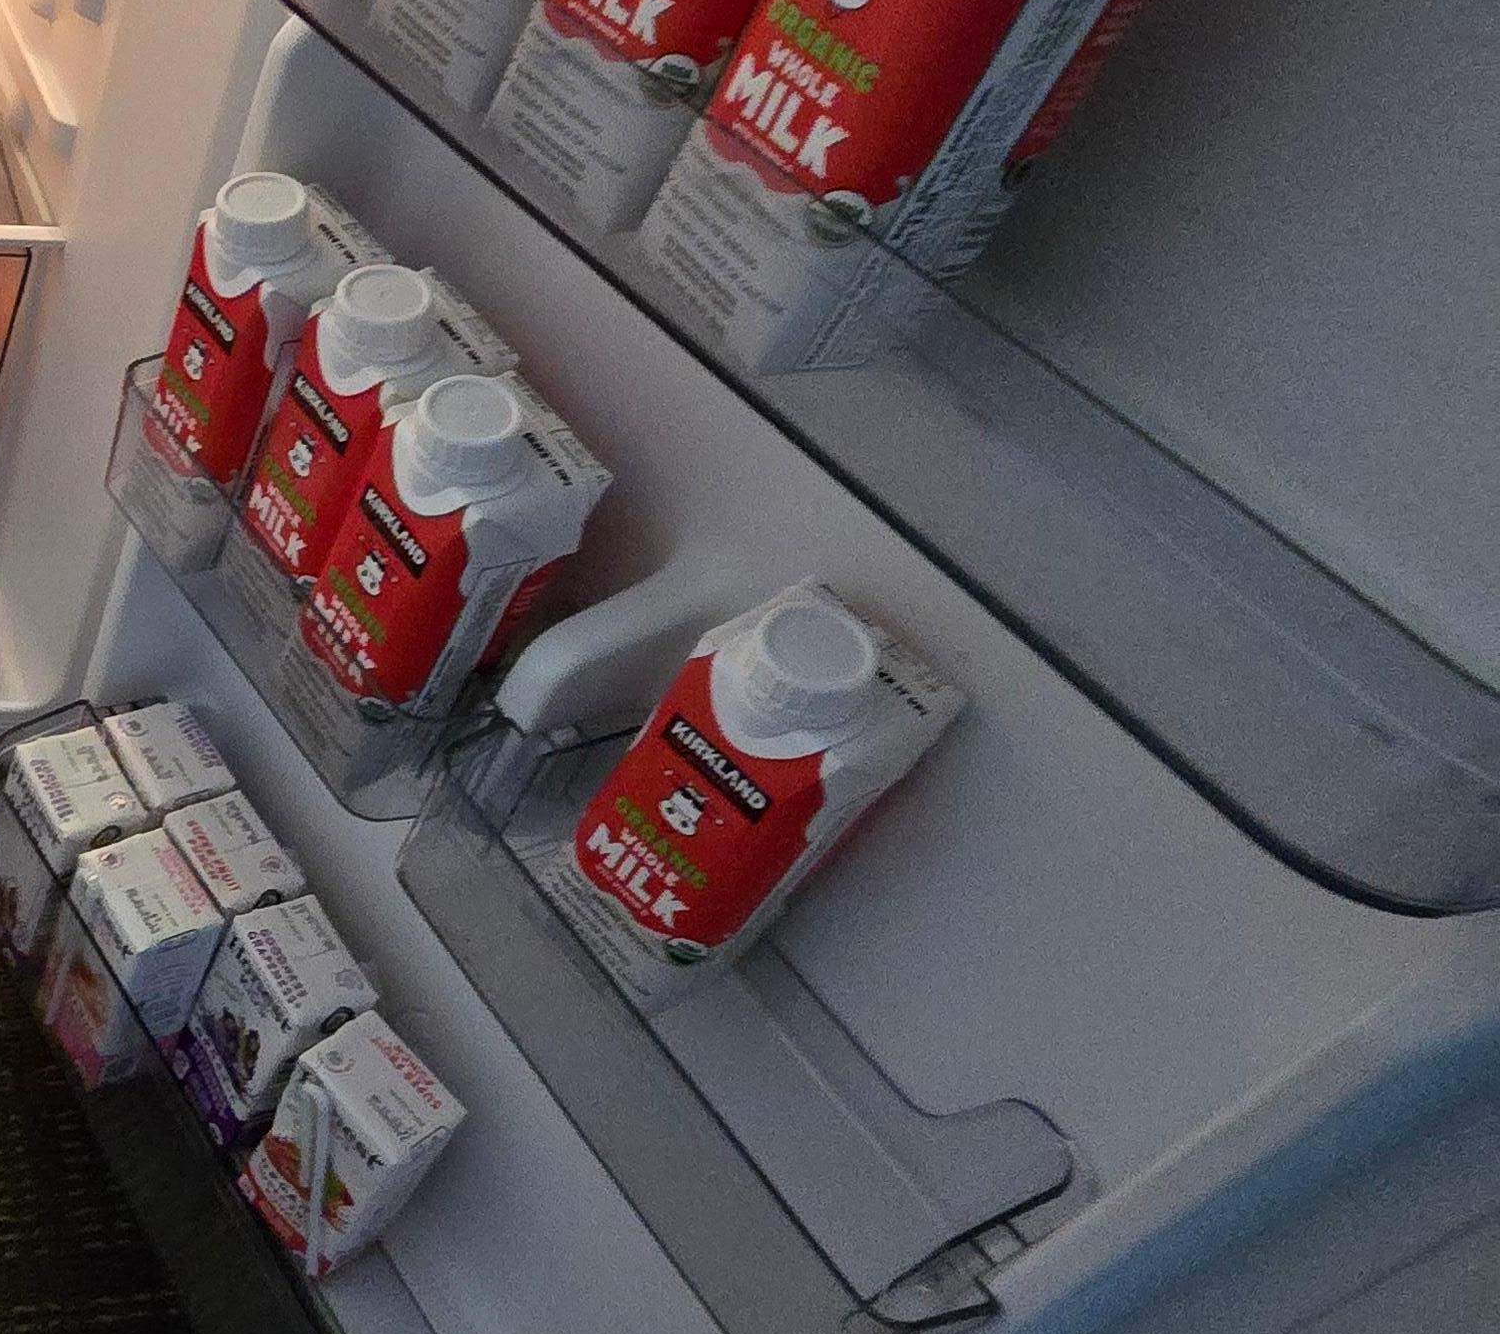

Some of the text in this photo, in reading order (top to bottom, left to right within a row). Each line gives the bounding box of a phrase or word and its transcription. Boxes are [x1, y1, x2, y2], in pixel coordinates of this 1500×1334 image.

[725, 52, 851, 180] MILK
[767, 40, 841, 108] WHOLE
[249, 482, 309, 567] MILK
[670, 719, 768, 811] KIRKLAND
[211, 857, 243, 893] FRUIT
[585, 821, 691, 930] MILK
[619, 825, 681, 888] WHOLE
